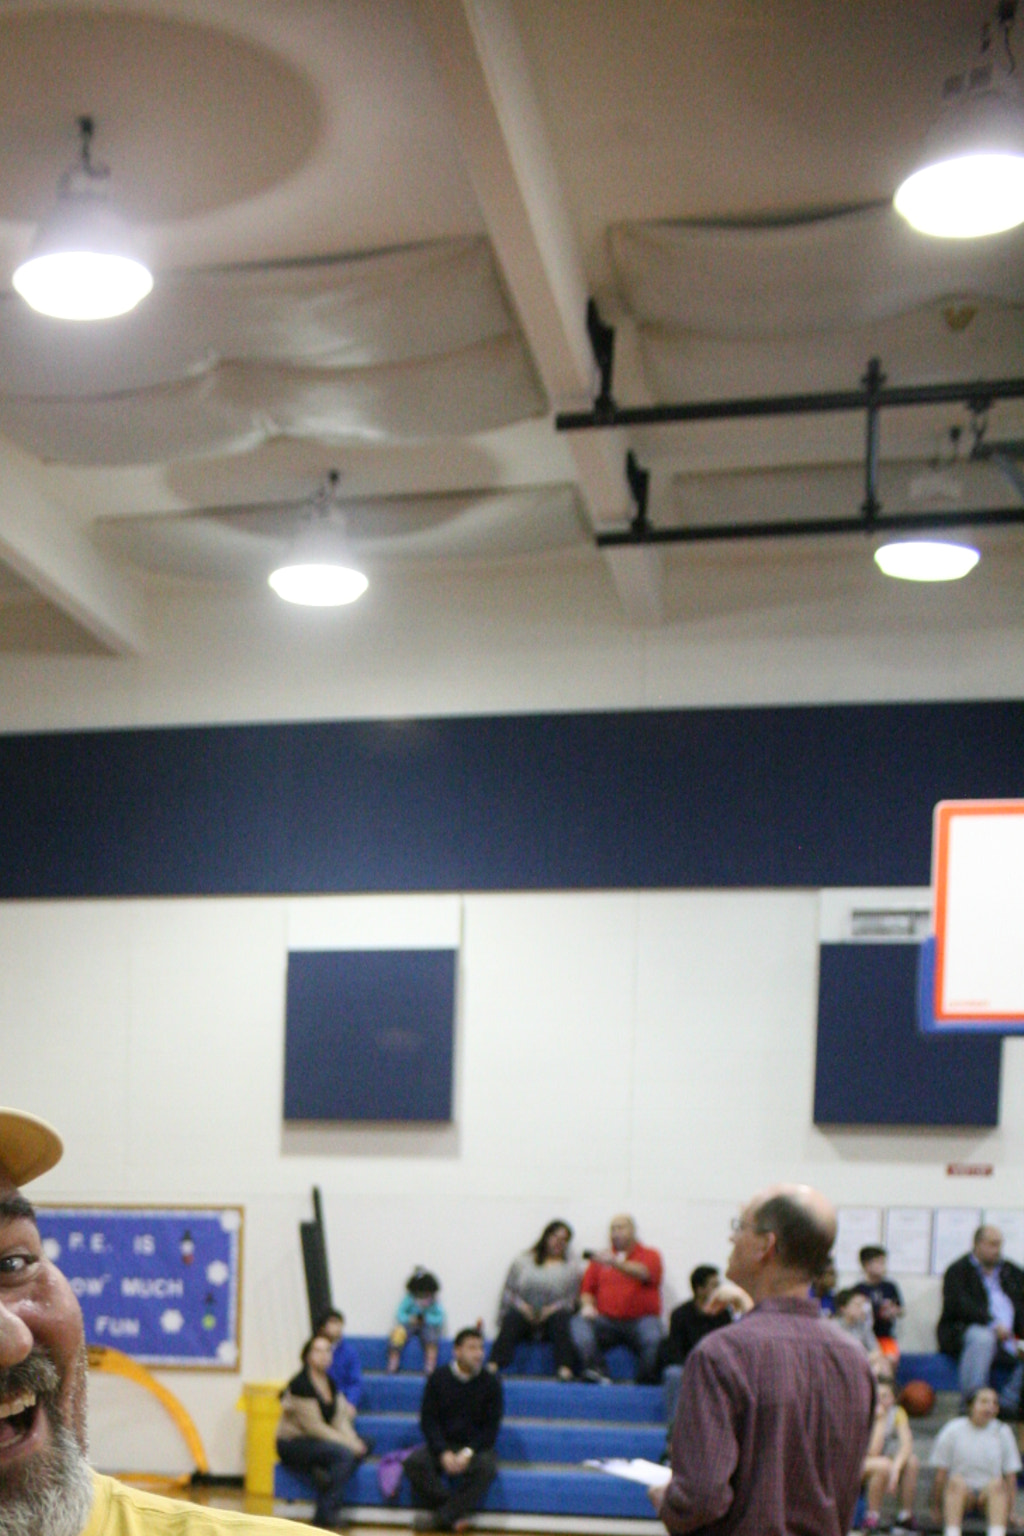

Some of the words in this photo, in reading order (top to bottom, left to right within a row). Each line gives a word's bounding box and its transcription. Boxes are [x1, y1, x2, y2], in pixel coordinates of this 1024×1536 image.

[132, 1234, 156, 1256] IS
[120, 1277, 184, 1299] MUCH
[94, 1315, 140, 1338] FUN
